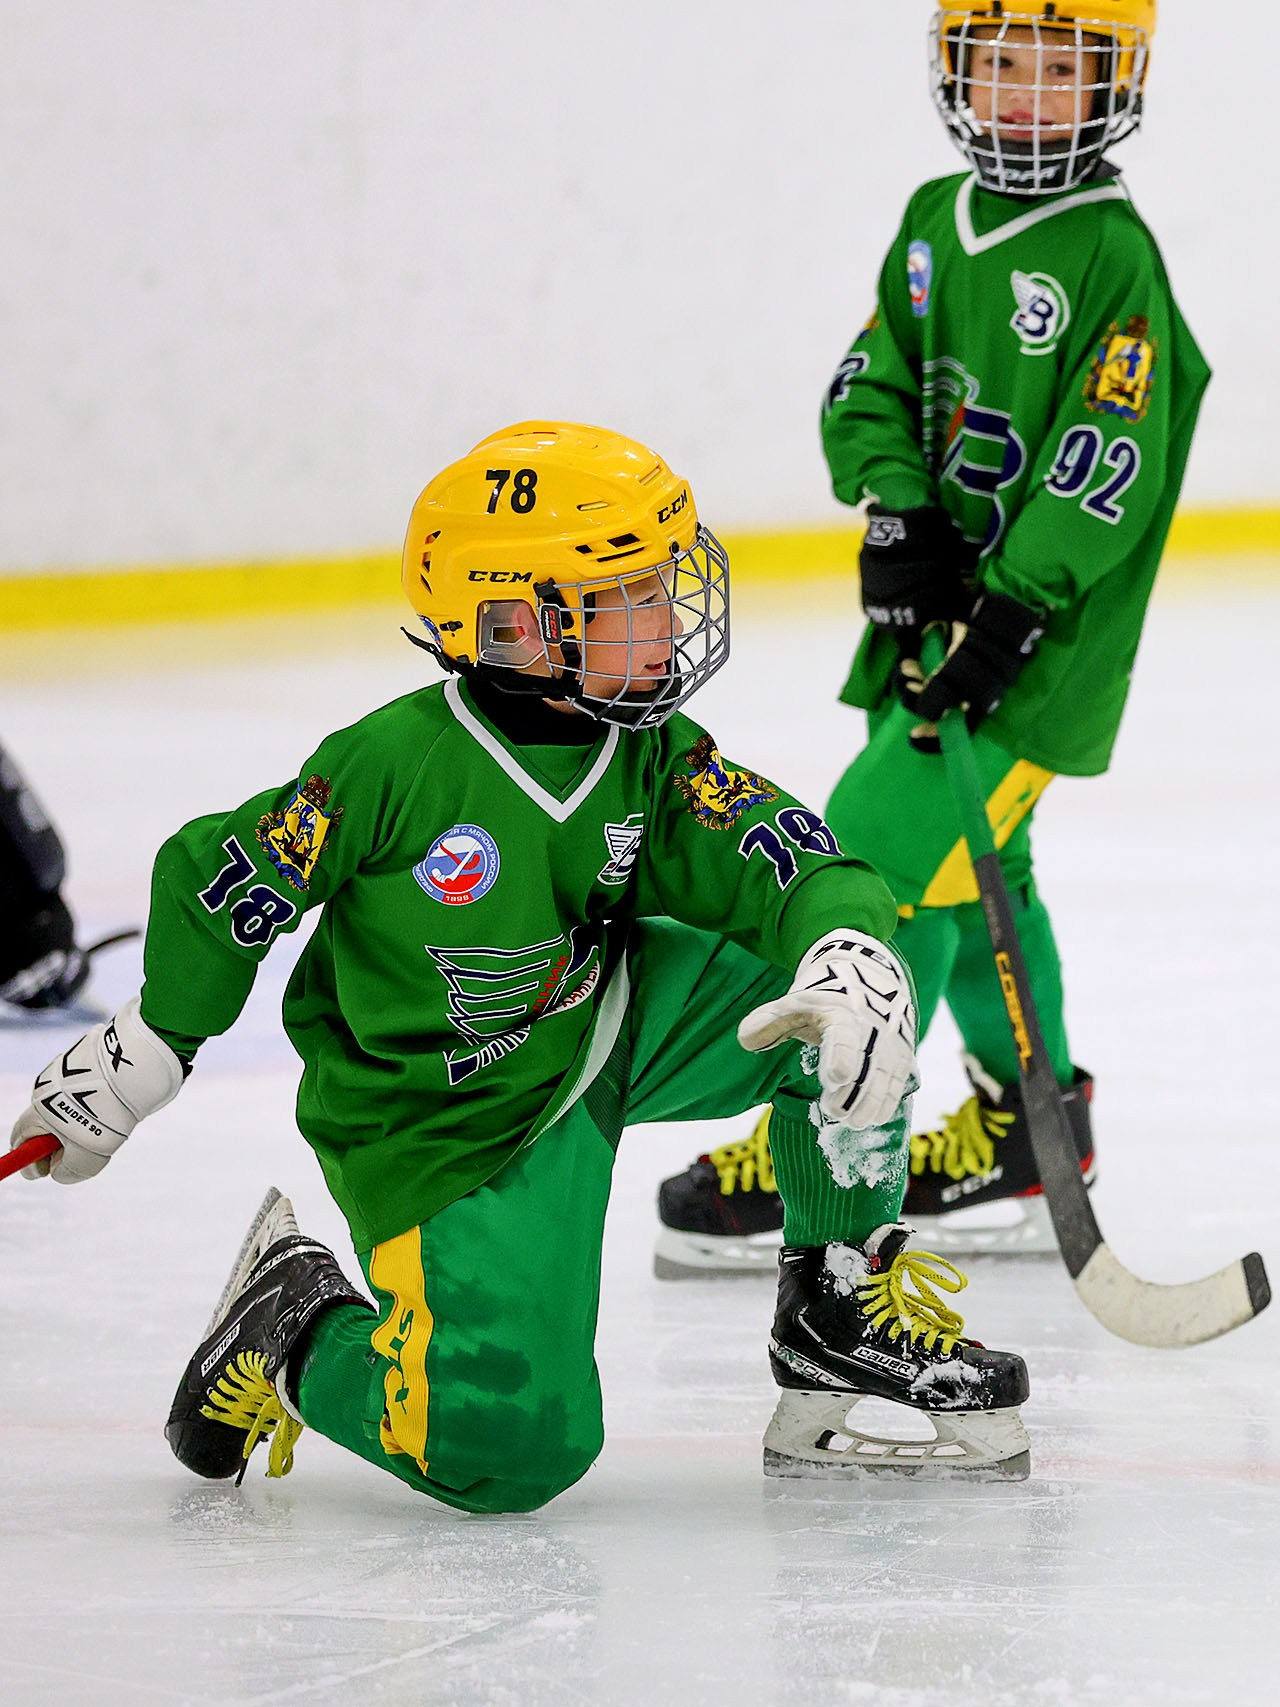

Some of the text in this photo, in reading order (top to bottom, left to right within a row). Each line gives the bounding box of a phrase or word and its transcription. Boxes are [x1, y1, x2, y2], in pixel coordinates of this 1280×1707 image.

[484, 468, 538, 515] 78
[1045, 425, 1142, 525] 92
[657, 488, 689, 525] CCM
[467, 569, 533, 584] CCM
[738, 806, 845, 892] 78
[196, 834, 298, 947] 78
[103, 1015, 135, 1073] EX
[56, 1100, 103, 1137] RAIDER 90
